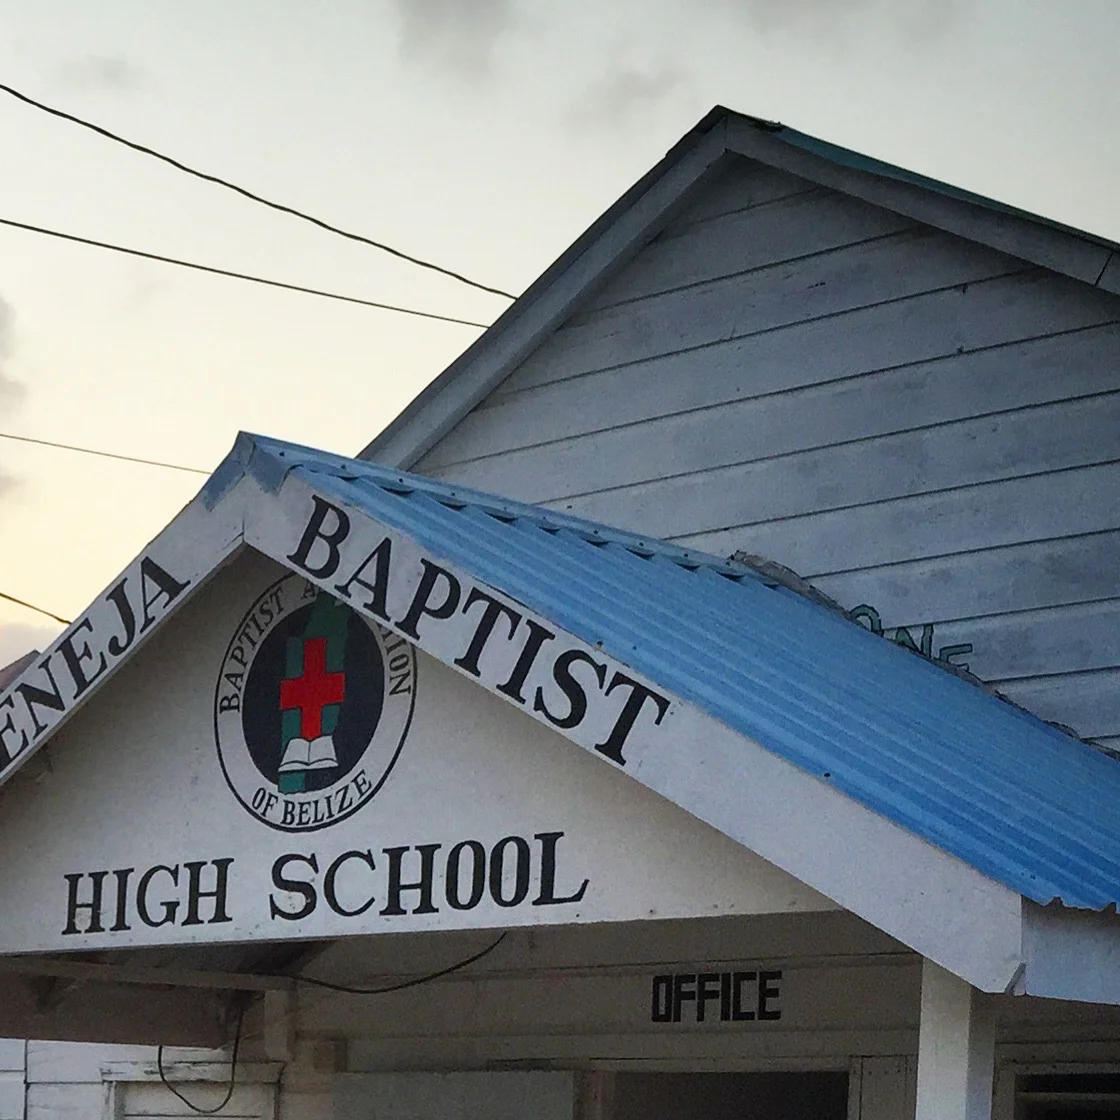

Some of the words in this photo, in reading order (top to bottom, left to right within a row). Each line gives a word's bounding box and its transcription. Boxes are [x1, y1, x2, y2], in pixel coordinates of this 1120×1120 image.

[219, 588, 285, 714] BAPTIST
[286, 494, 671, 766] BAPTIST
[252, 786, 279, 817] OF
[281, 769, 372, 825] BELIZE
[61, 857, 234, 935] HIGH
[269, 831, 590, 921] SCHOOL
[651, 970, 782, 1022] OFFICE
